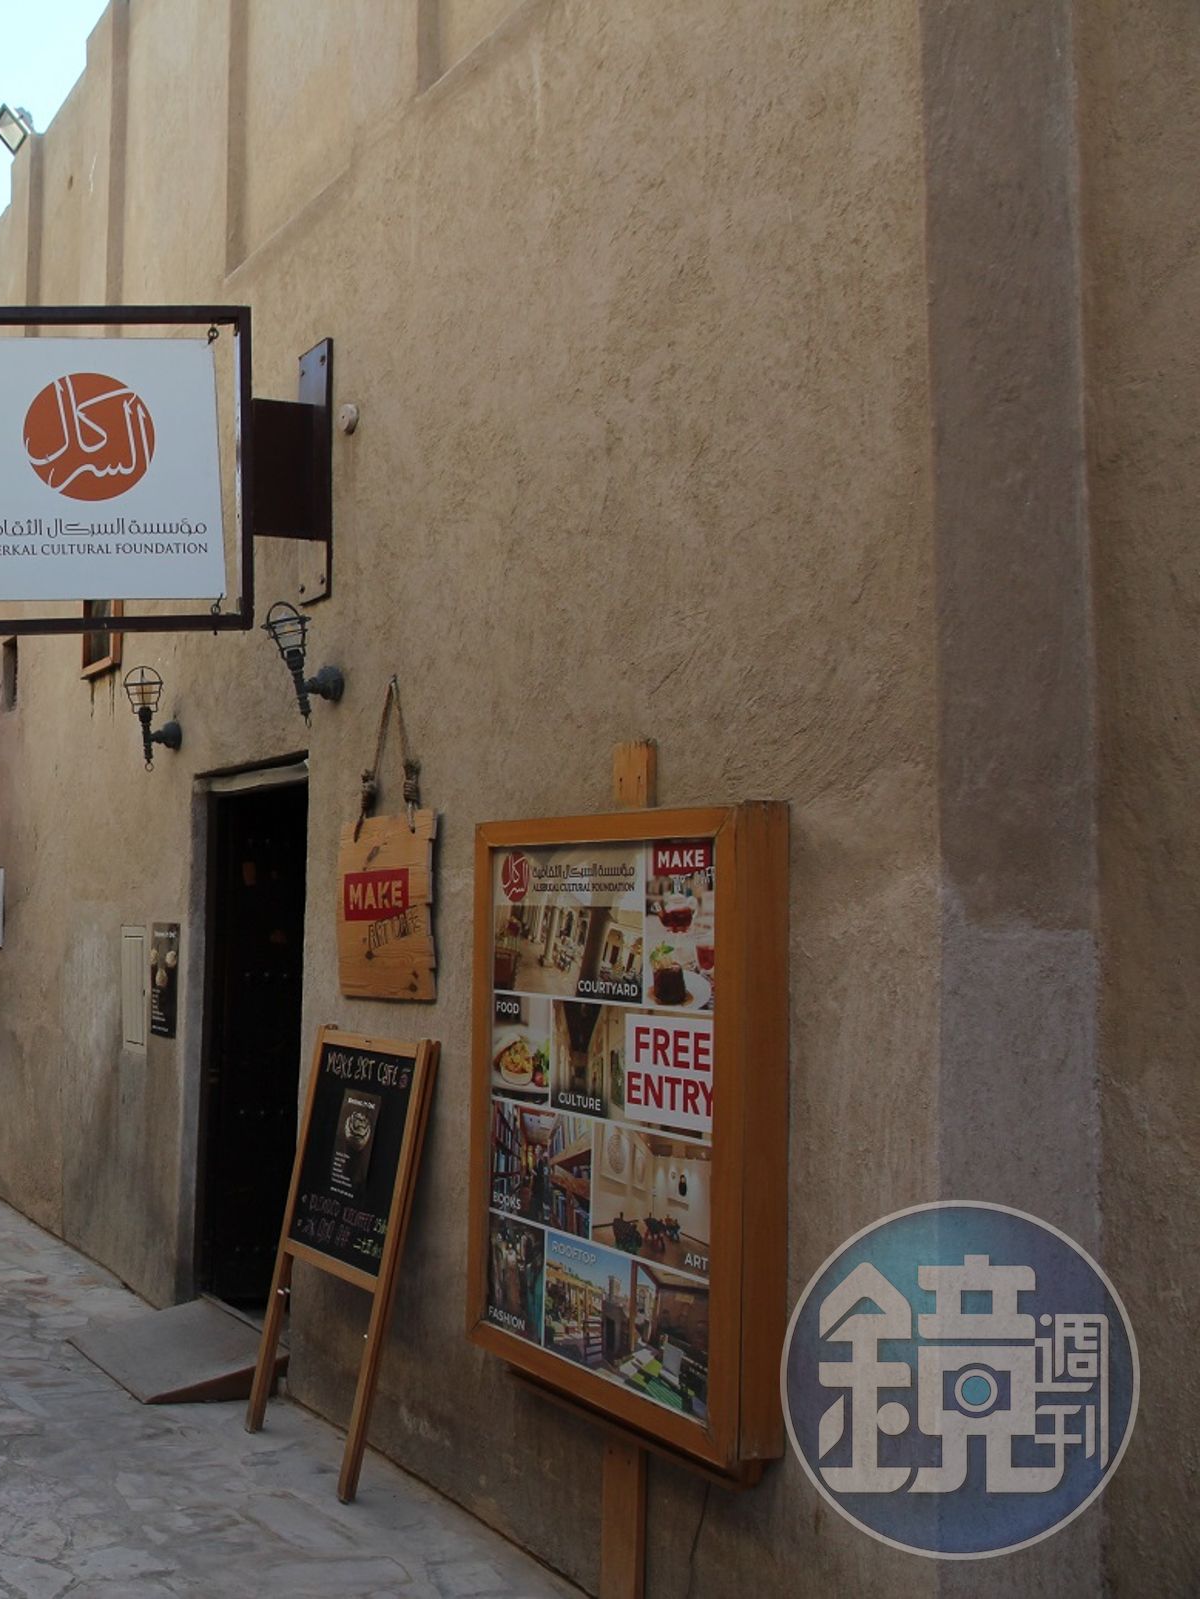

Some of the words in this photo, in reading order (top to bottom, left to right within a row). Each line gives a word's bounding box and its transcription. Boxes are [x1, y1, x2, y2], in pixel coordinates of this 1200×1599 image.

[47, 517, 125, 538] السركال
[128, 517, 207, 537] مؤسسة
[41, 542, 112, 556] CULTURAL
[115, 541, 208, 555] FOUNDATION
[657, 849, 705, 868] MAKE
[349, 880, 404, 911] MAKE
[560, 882, 590, 892] CULTURAL
[591, 882, 635, 892] FOUNDATION
[577, 979, 638, 997] COURTYARD
[496, 1002, 519, 1014] FOOD
[634, 1026, 711, 1072] FREE
[558, 1092, 601, 1111] CULTURE
[626, 1071, 714, 1118] ENTRY
[492, 1191, 522, 1210] BOOKS
[551, 1240, 598, 1266] ROOFTOP
[684, 1252, 709, 1272] ART
[488, 1305, 526, 1331] FASHION
